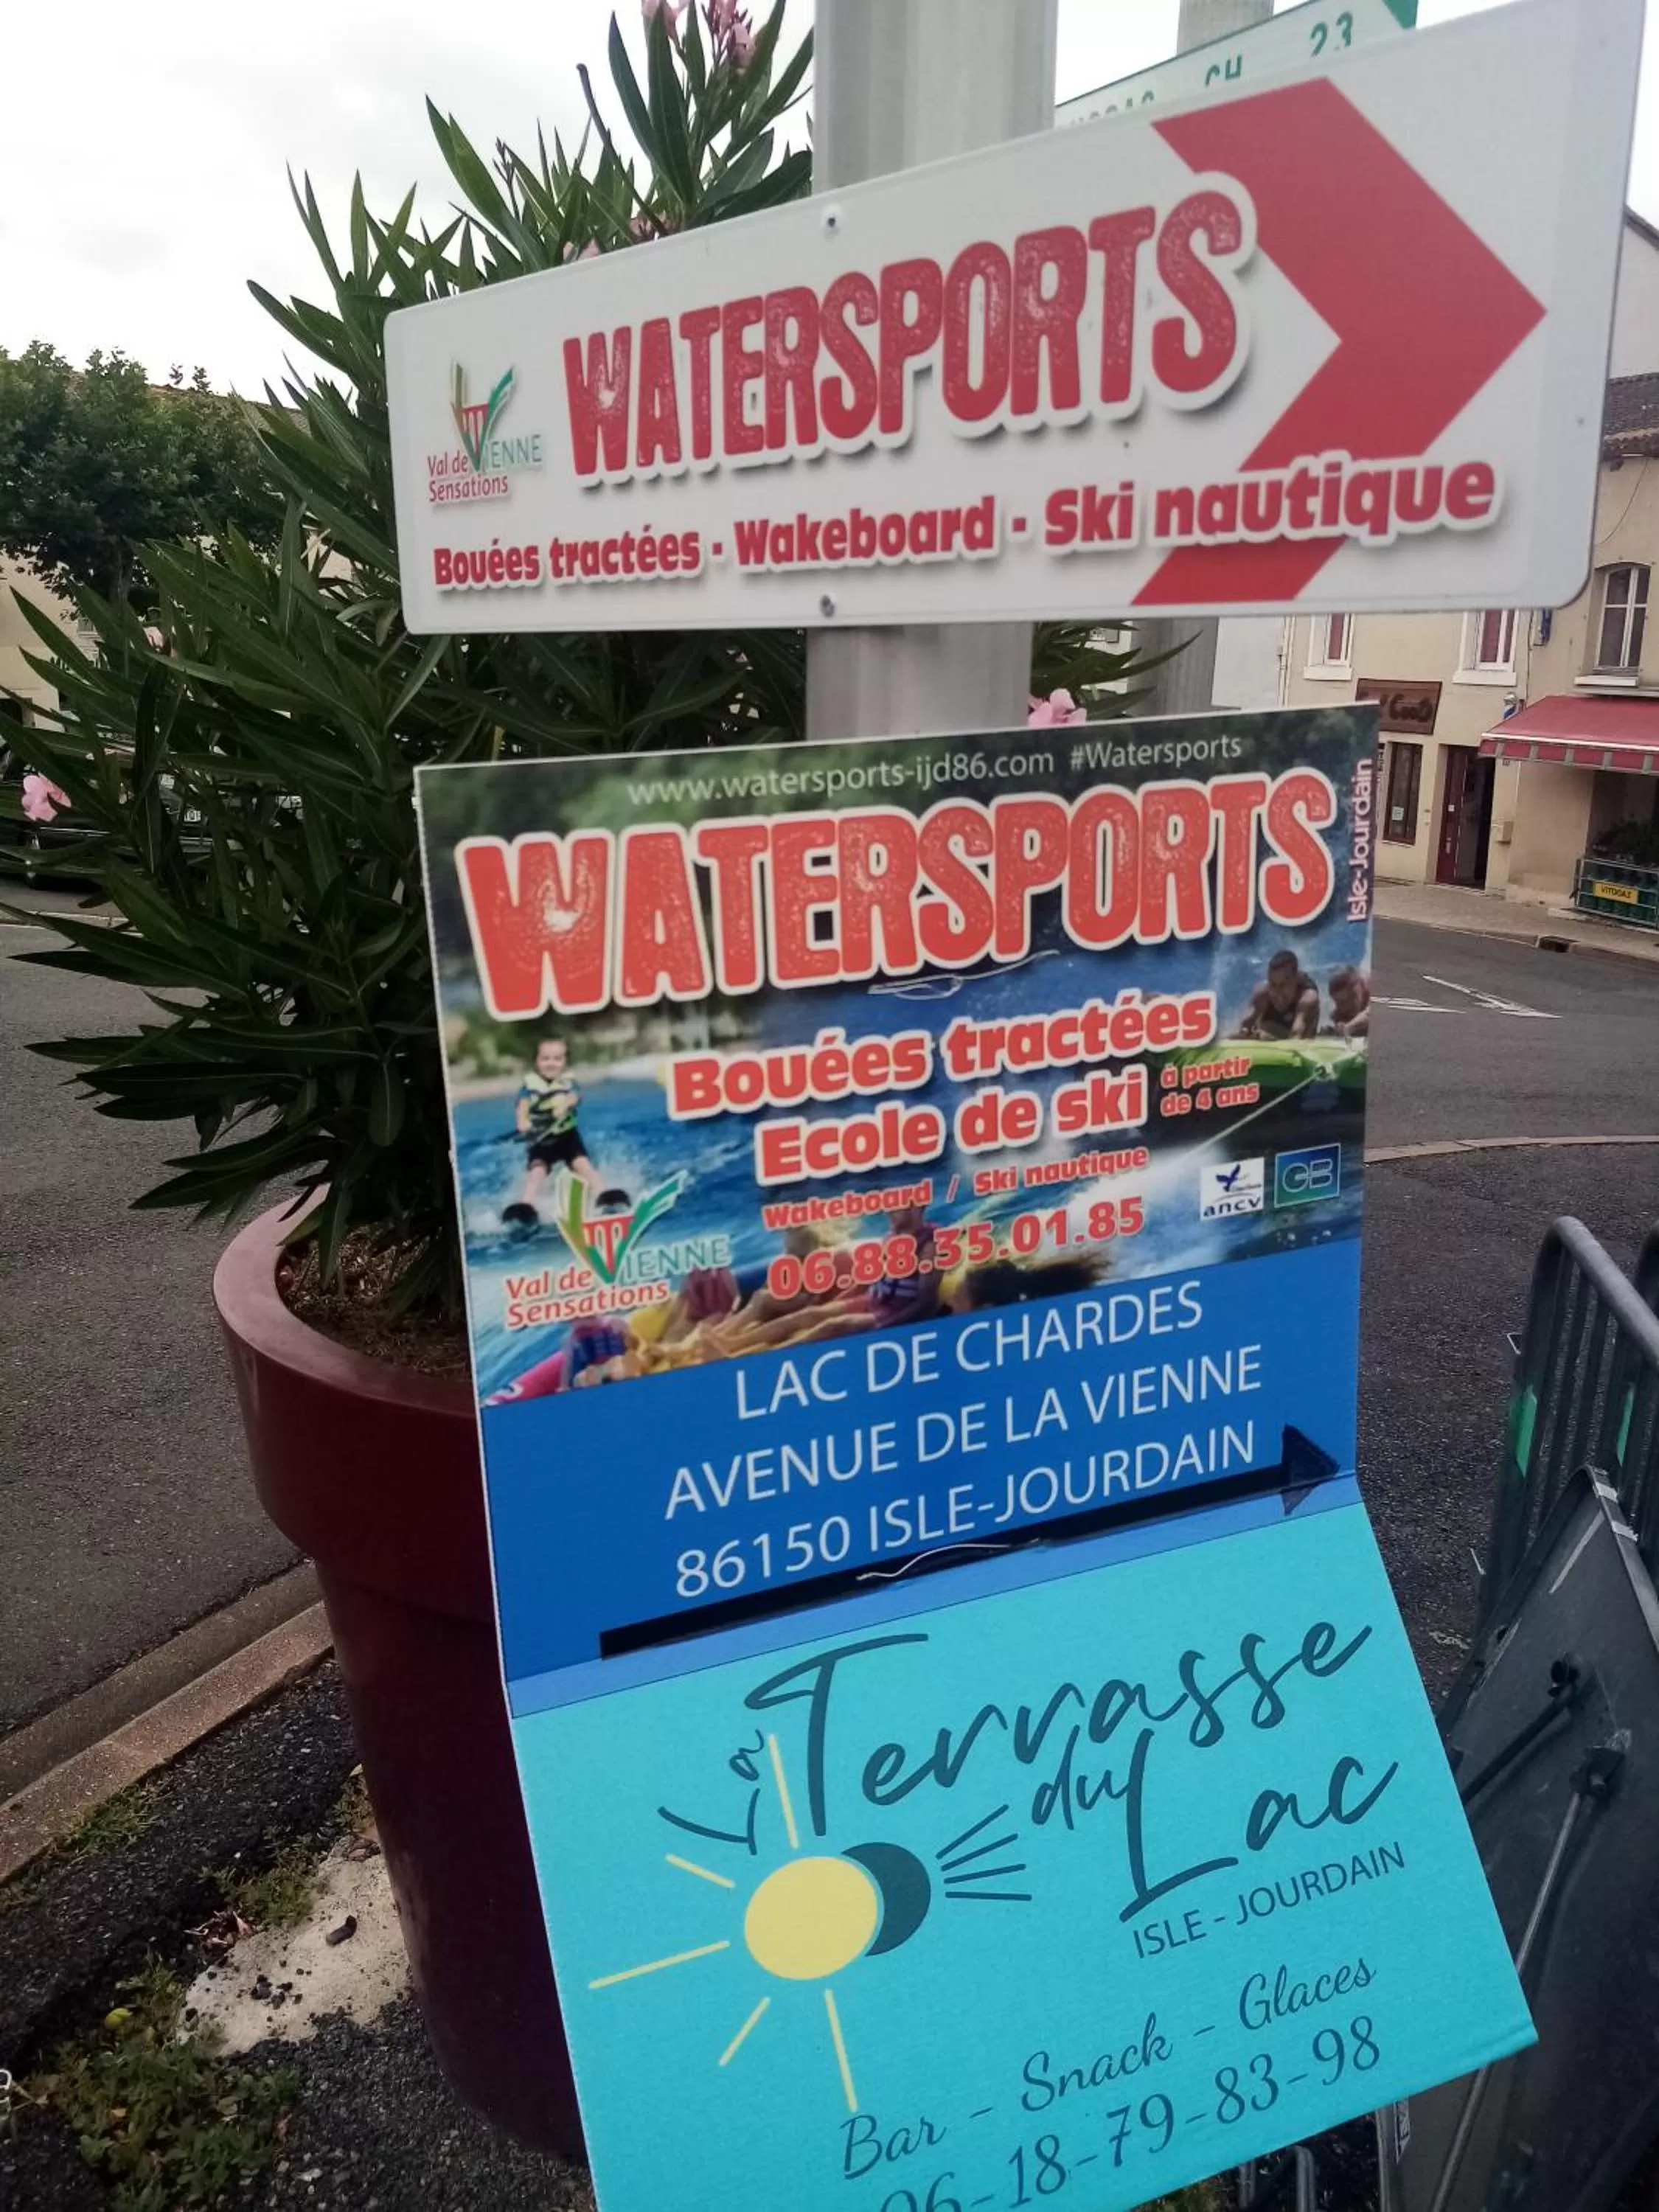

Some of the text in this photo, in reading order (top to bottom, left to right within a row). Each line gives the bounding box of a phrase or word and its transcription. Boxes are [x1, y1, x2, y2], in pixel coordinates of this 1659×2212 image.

[563, 190, 1242, 476] WATERSPORTS
[427, 451, 448, 479] Val
[452, 450, 469, 474] de
[428, 474, 509, 503] Sensations
[434, 538, 540, 585] Bouées
[549, 524, 700, 578] tractées
[734, 495, 996, 566] Wakeboard
[1044, 481, 1135, 547] Ski
[1154, 459, 1495, 539] nautique
[627, 734, 1243, 806] www.watersports-ijd86.com #Watersports
[461, 771, 1333, 1016] WATERSPORTS
[1346, 758, 1374, 923] Isle-Jourdain
[672, 993, 1212, 1114] Bouées tractées
[1161, 1082, 1260, 1116] de 4 ans
[1183, 1056, 1251, 1088] partir
[761, 1072, 1142, 1178] Ecole de ski
[764, 1180, 931, 1229] Wakeboard
[975, 1171, 1017, 1194] Ski
[1024, 1148, 1149, 1188] nautique
[1203, 1196, 1262, 1217] ancv
[506, 1271, 549, 1300] Val
[559, 1266, 593, 1290] de
[507, 1281, 669, 1328] Sensations
[767, 1196, 1144, 1301] 06.88.35.01.85
[736, 1281, 1203, 1419] LAC DE CHARDES
[664, 1344, 1263, 1520] AVENUE DE LA VIENNE
[675, 1420, 1255, 1599] 86150 ISLE-JOURDAIN
[743, 1621, 1372, 1836] Terrasse
[1032, 1724, 1399, 1924] du Lac
[1133, 1909, 1207, 1959] ISLE
[1236, 1842, 1405, 1927] JOURDAIN
[838, 2114, 947, 2180] Bar
[1021, 2011, 1173, 2112] Snack
[1239, 1957, 1377, 2031] Glaces
